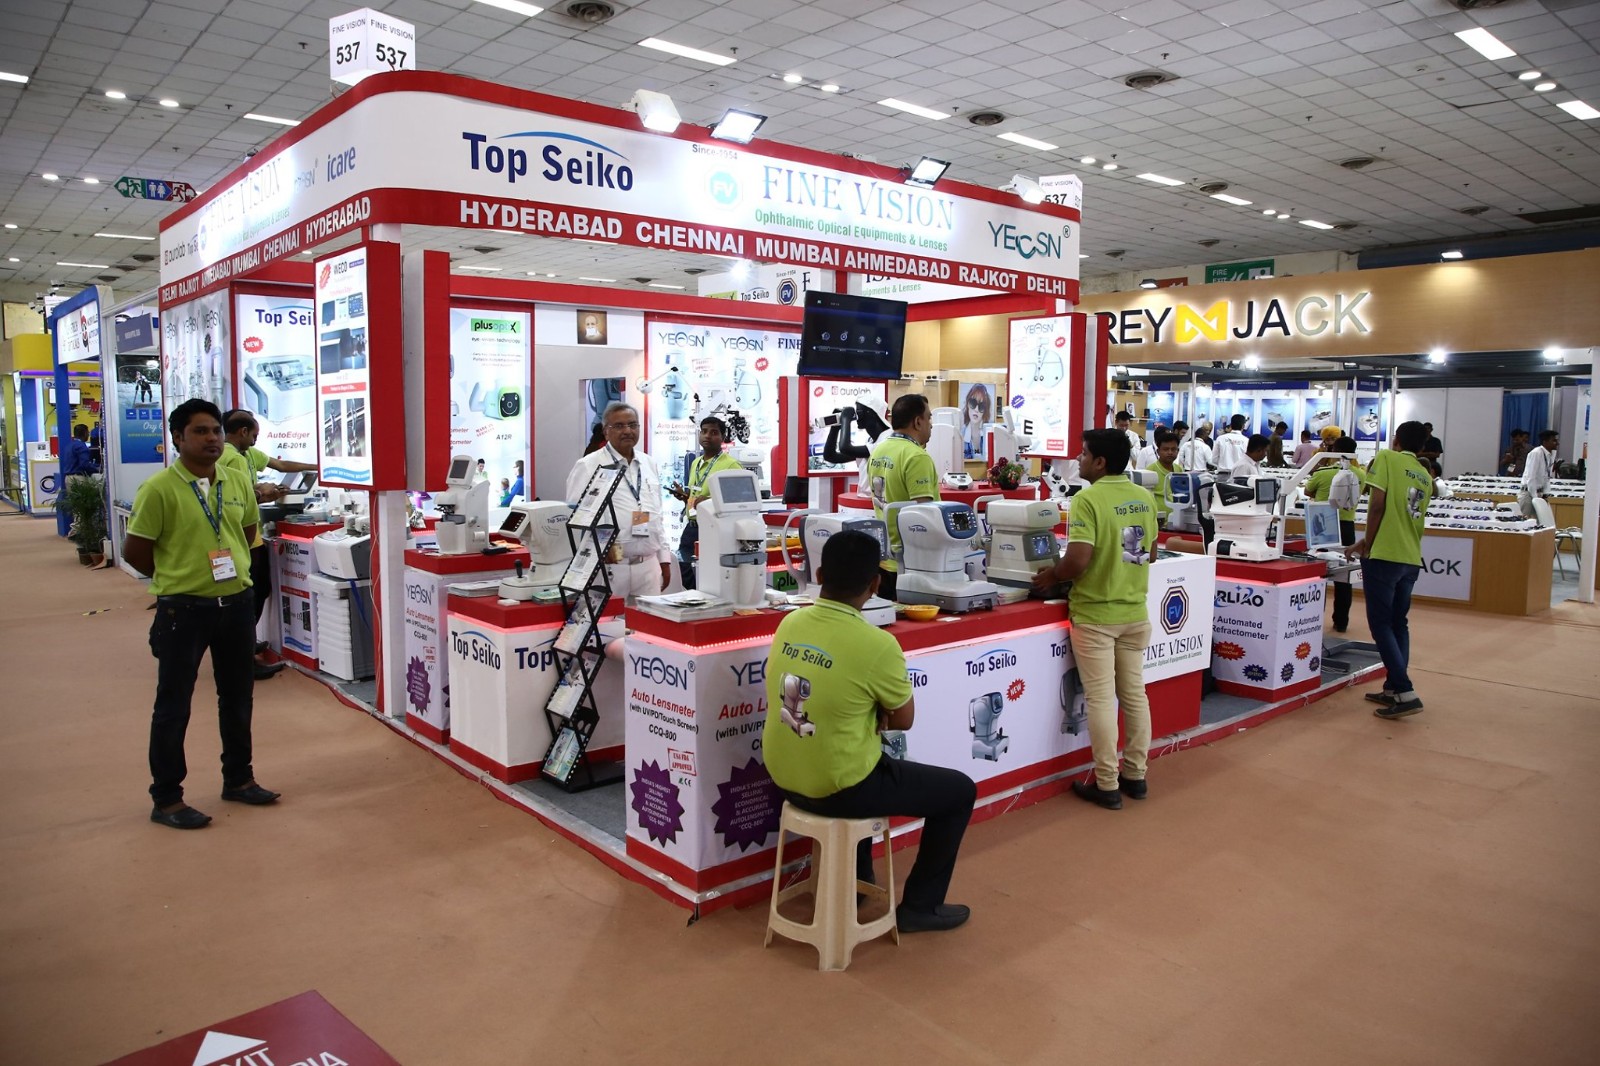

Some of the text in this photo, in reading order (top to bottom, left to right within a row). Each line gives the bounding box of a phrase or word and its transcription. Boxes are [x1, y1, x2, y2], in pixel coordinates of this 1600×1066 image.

[332, 18, 366, 35] FINE VISION
[370, 19, 414, 41] FINE VISION
[336, 41, 361, 65] 537
[376, 43, 407, 68] 537
[327, 146, 356, 182] icare
[462, 131, 634, 191] Top Seiko
[763, 165, 954, 230] FINE VISION
[755, 209, 948, 252] Ophthalmic Optical Equipments & Lenses
[162, 196, 371, 303] DELHI RAJKOT AHMEDABAD MUMBAI CHENNAI HYDERABAD
[460, 200, 1066, 296] HYDERABAD CHENNAI MUMBAI AHMEDABAD RAJKOT DELHI
[1212, 268, 1228, 277] FIRE
[898, 283, 922, 293] Lenses
[255, 309, 315, 327] Top Sei
[1232, 291, 1373, 339] JACK
[267, 431, 310, 440] AutoEdger
[1024, 419, 1033, 435] E
[277, 442, 307, 450] AE-2018
[870, 458, 880, 468] Top
[1405, 469, 1416, 479] Top
[1114, 504, 1149, 516] Top Seiko
[1289, 589, 1321, 607] FARLIAO
[1168, 604, 1182, 619] FV
[1217, 615, 1263, 629] Automated
[1287, 615, 1320, 629] Fully Automated
[1212, 624, 1269, 641] Refractometer
[1283, 624, 1322, 640] Auto Refractometer
[451, 630, 469, 660] Top
[472, 638, 501, 671] Seiko
[1050, 643, 1067, 658] Top
[1169, 634, 1204, 656] VISION
[514, 647, 554, 672] Top
[781, 642, 833, 669] Top Seiko
[965, 653, 1017, 677] Top Seiko
[1010, 681, 1022, 697] NEW
[631, 687, 696, 718] Auto Lensmeter
[718, 702, 753, 721] Auto
[648, 723, 677, 742] CCQ-800
[676, 718, 699, 735] Screen)
[715, 727, 738, 742] (with
[672, 761, 693, 772] APPROVED
[734, 794, 769, 809] ECONOMICAL
